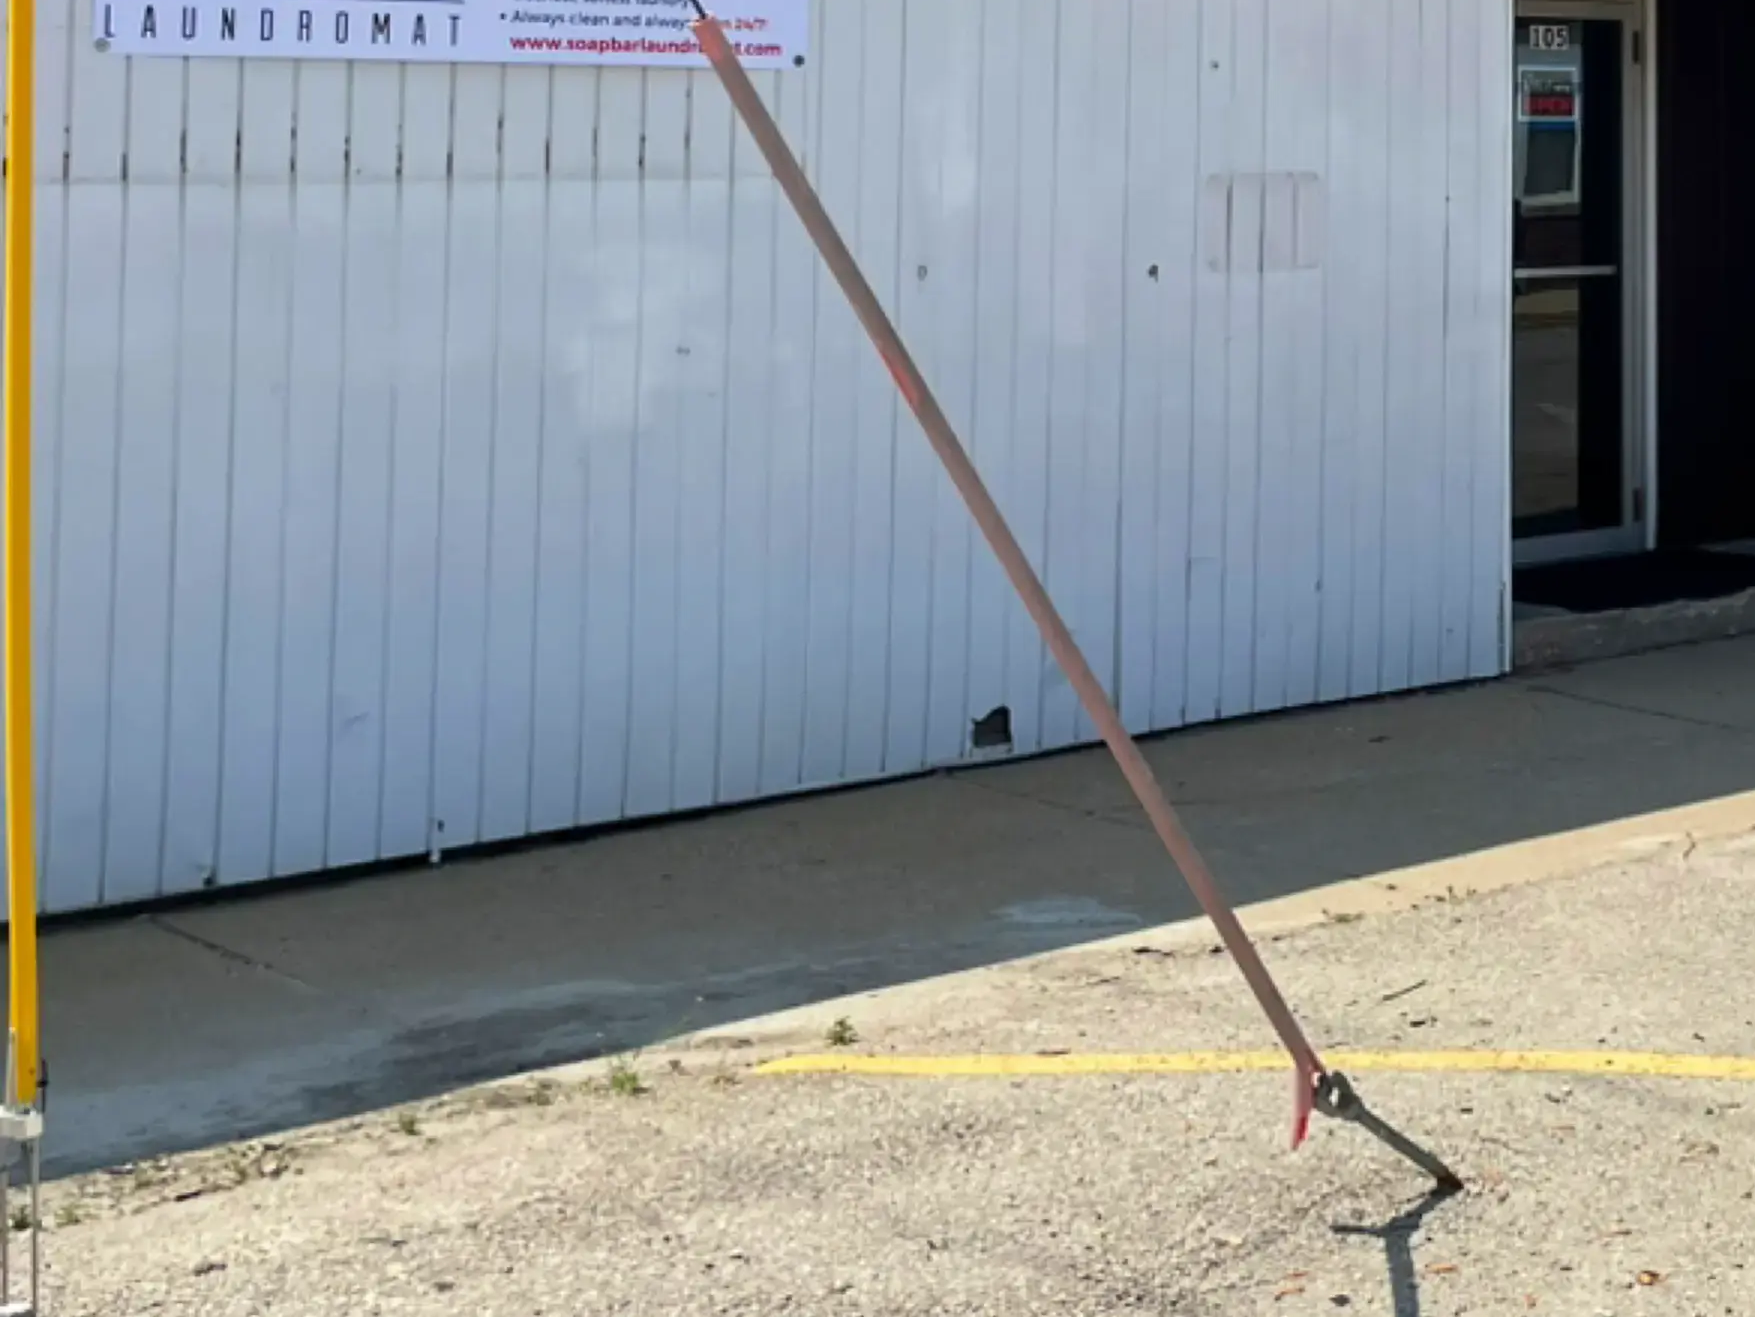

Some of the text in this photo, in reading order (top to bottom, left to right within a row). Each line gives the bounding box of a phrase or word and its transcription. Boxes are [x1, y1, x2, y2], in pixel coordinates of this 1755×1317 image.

[104, 4, 462, 47] LAUNDROMAT
[510, 10, 565, 28] Always
[569, 11, 610, 26] clean
[612, 13, 642, 27] and
[510, 36, 782, 57] www.soapbarlaundrt.com
[1532, 27, 1567, 47] 105
